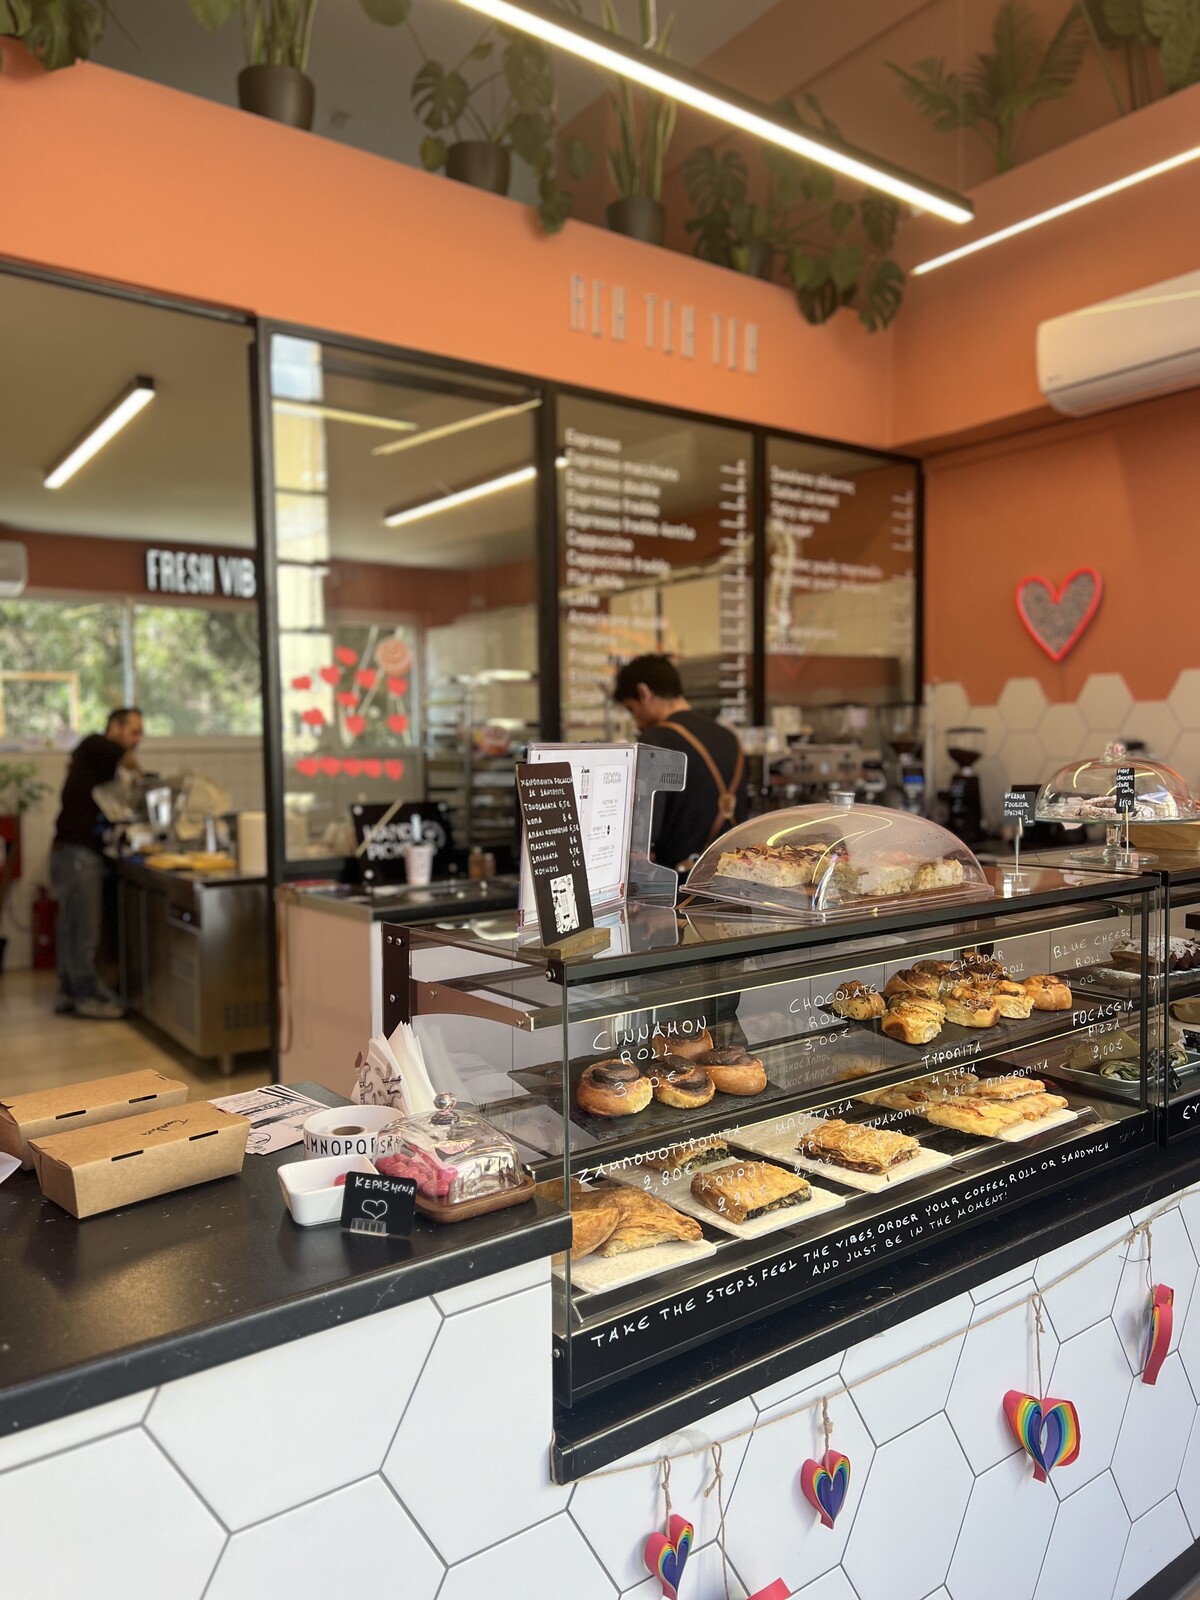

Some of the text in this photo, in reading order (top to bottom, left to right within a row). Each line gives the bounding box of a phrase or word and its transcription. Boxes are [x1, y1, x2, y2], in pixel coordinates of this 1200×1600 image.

[146, 548, 215, 596] FRESH
[1053, 928, 1131, 958] BLUE CHEESE
[949, 950, 1004, 972] CHEDDAR
[1002, 962, 1025, 976] ROLL
[1075, 954, 1101, 968] ROLL
[789, 983, 878, 1013] CHOCOLATE
[592, 1015, 707, 1050] CINNAMON
[808, 1009, 848, 1029] ROLL
[1088, 1019, 1120, 1037] PIZZA
[620, 1044, 673, 1066] ROLL
[922, 1041, 982, 1069] ΤΥΡΟΠΙΤΑ
[944, 1063, 976, 1082] ΤΥΡΙΑ
[577, 1124, 743, 1185] ΖΑΜΠΟΝΟΤΥΡΟΠΙΤΑ
[354, 1176, 415, 1196] ΚΕΡΑΣΜΕΝΑ
[643, 1162, 694, 1192] 2,80€
[701, 1161, 766, 1191] ΚΟΥΡΟΥ
[590, 1316, 650, 1347] TAKE
[659, 1298, 697, 1320] THE
[705, 1275, 758, 1304] STEPS,
[762, 1260, 798, 1280] FEEL
[803, 1245, 830, 1263] THE
[877, 1213, 919, 1234] ORDER
[925, 1197, 959, 1217] YOUR
[964, 1179, 1009, 1200] COFFEE,
[1009, 1167, 1037, 1184] ROLL
[1041, 1159, 1057, 1171] OR
[1061, 1141, 1110, 1164] SANDWICH
[812, 1191, 1009, 1276] AND JUST BE IN THE MOMENT!
